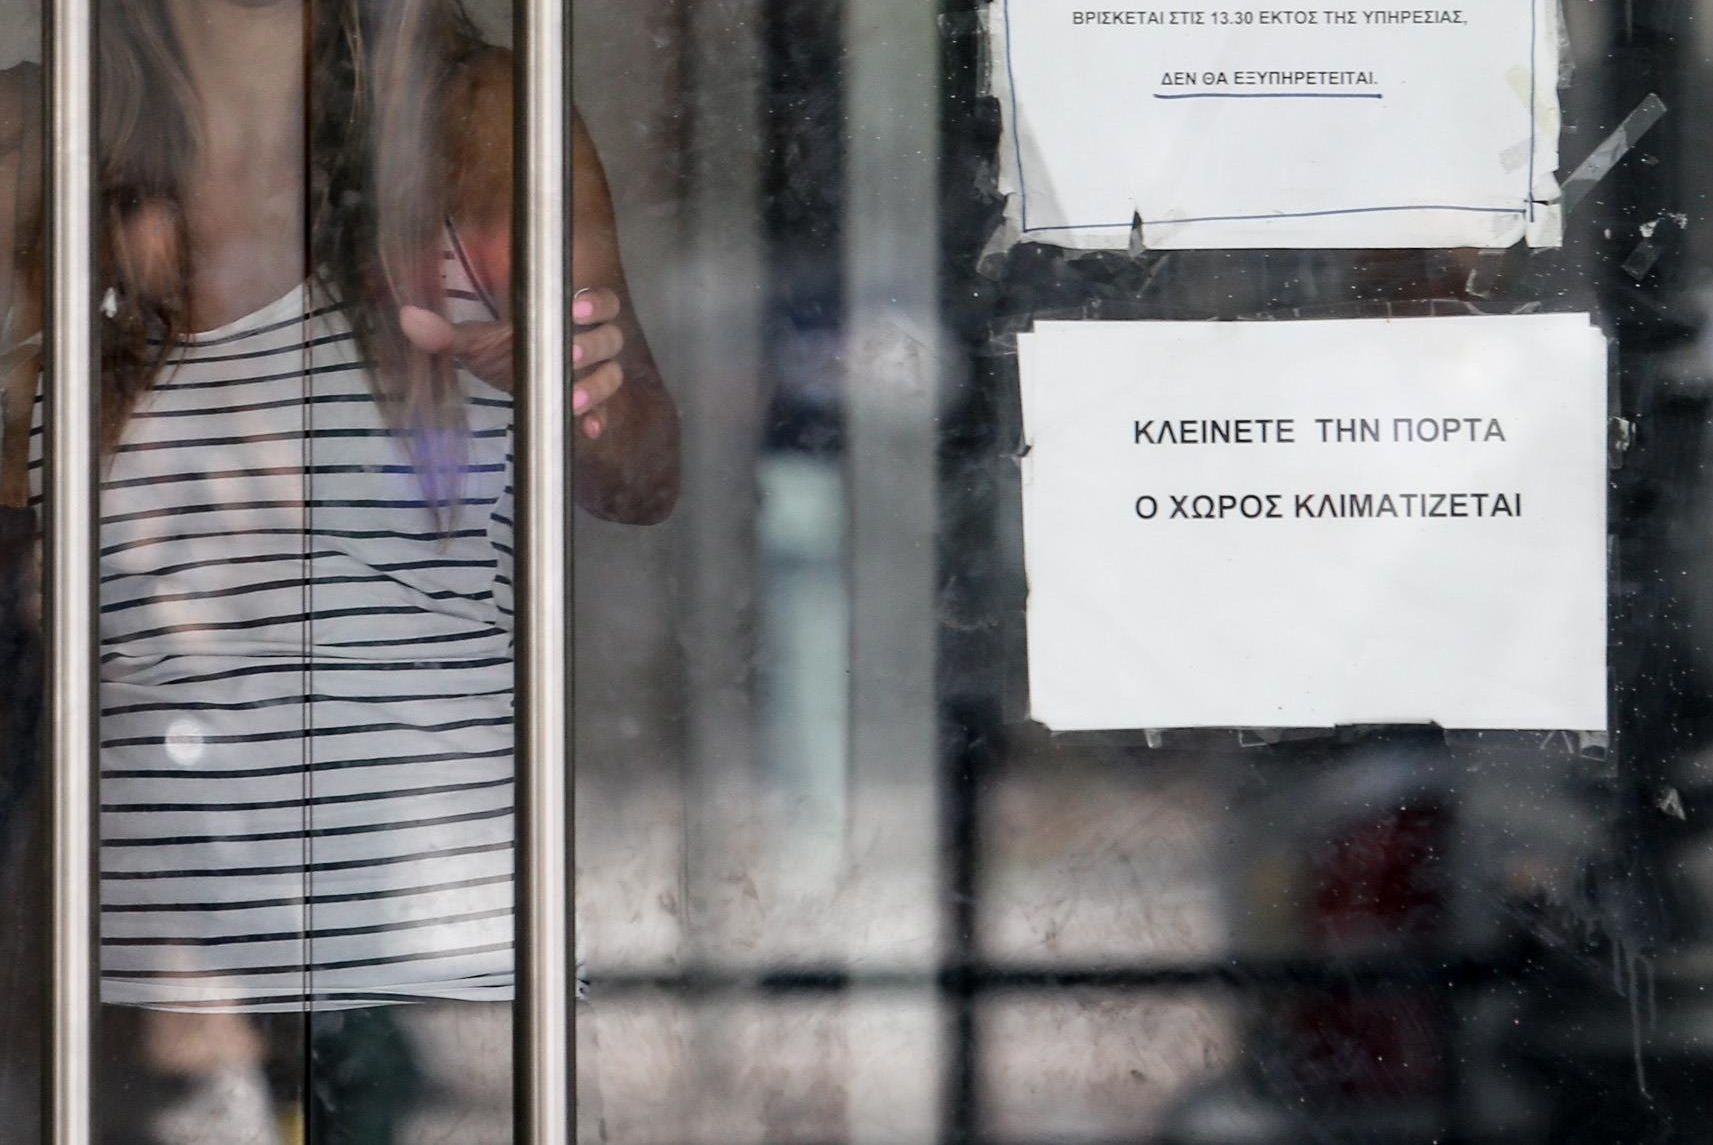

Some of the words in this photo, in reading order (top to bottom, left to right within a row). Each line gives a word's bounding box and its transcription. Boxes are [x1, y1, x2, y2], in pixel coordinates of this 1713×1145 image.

[1073, 12, 1163, 24] ΒΡΙΣΚΕΤΑΙ
[1170, 12, 1204, 24] ΣΤΙΣ
[1212, 12, 1253, 24] 13.30
[1260, 11, 1317, 24] ΕΚΤΟΣ
[1324, 11, 1357, 24] ΤΗΣ
[1363, 11, 1467, 25] ΥΠΗΡΕΣΙΑΣ,
[1162, 72, 1196, 85] ΔΕΝ
[1203, 72, 1228, 85] ΘΑ
[1234, 72, 1376, 84] ΕΞΥΠΗΡΕΤΕΙΤΑΙ.
[1133, 419, 1295, 445] ΚΛΕΙΝΕΤΕ
[1315, 418, 1379, 443] ΤΗΝ
[1392, 418, 1506, 443] ΠΟΡΤΑ
[1135, 495, 1158, 520] Ο
[1168, 494, 1282, 519] ΧΩΡΟΣ
[1294, 492, 1523, 519] ΚΛΙΜΑΤΙΖΕΤΑΙ
